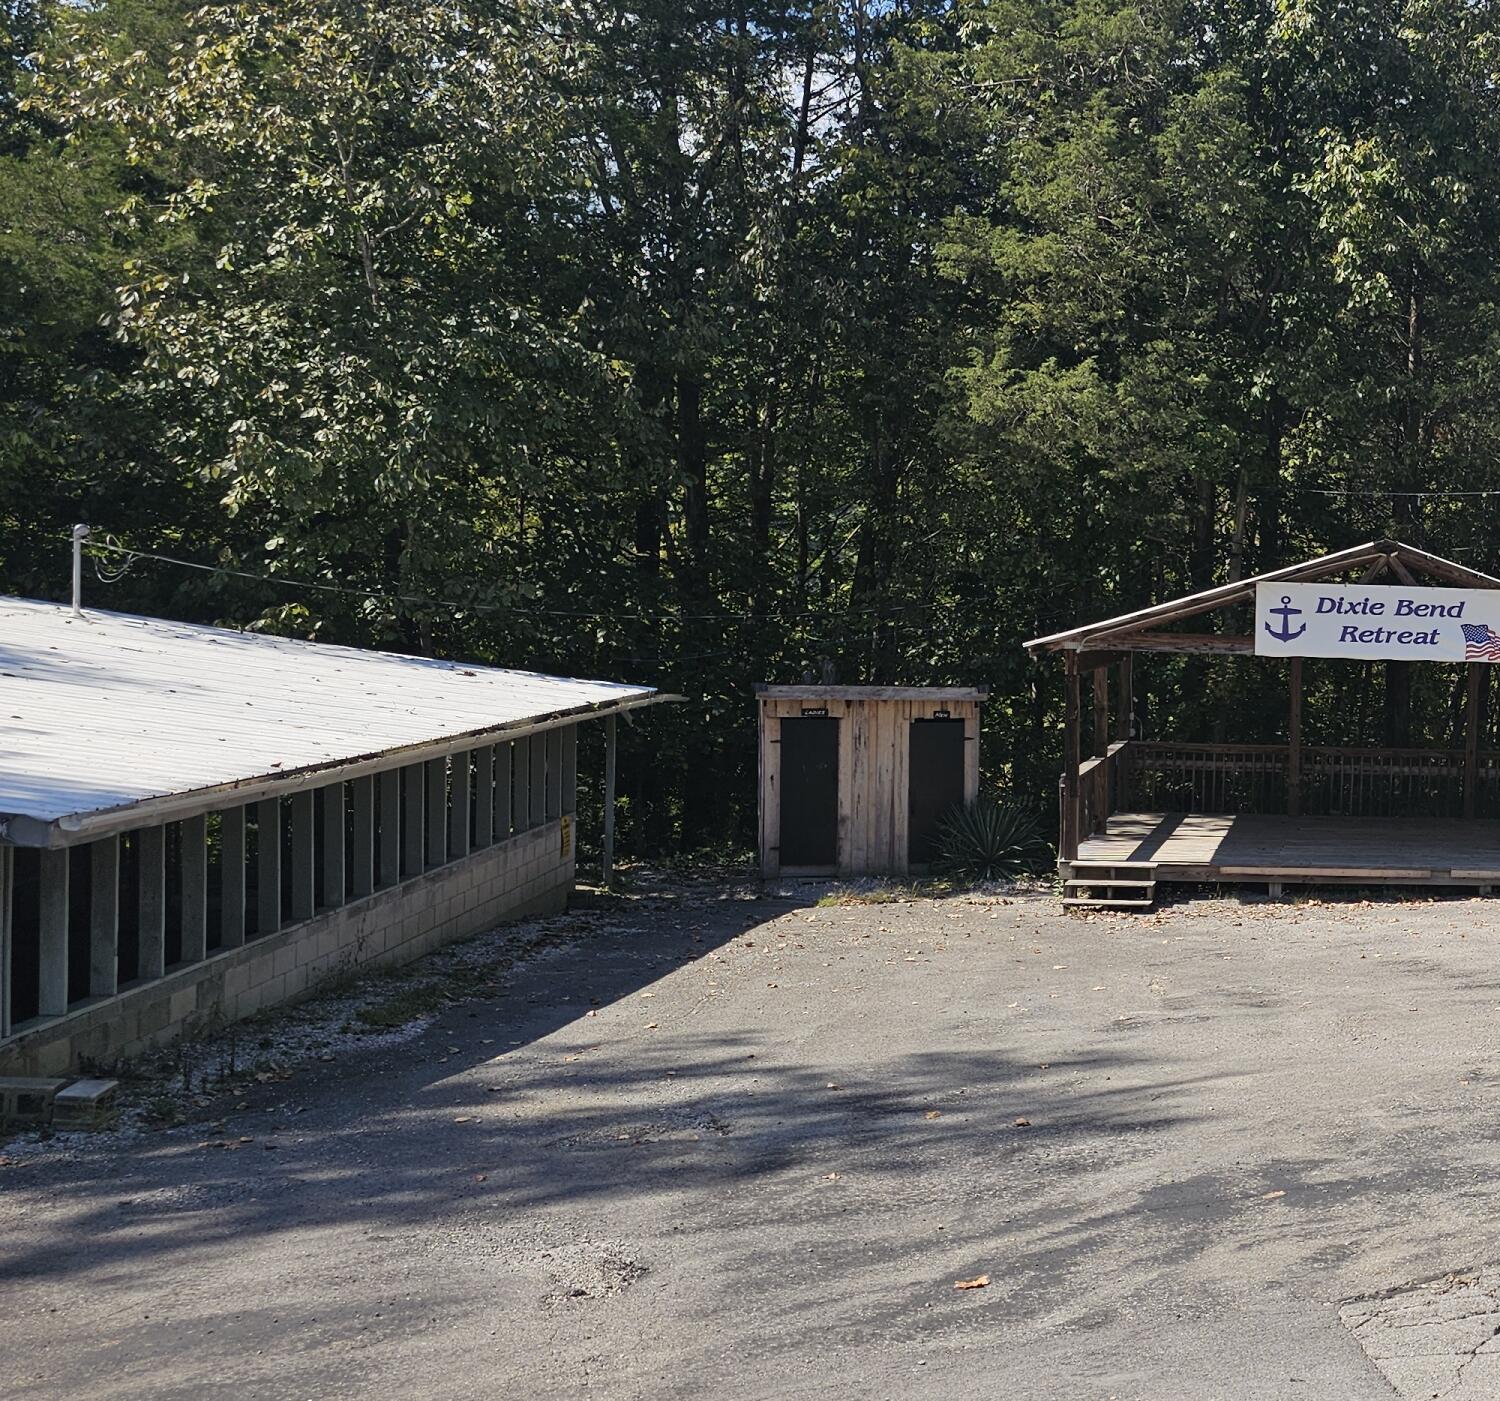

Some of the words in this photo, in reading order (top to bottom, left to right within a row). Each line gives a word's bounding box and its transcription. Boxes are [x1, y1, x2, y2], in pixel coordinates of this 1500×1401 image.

[1315, 597, 1385, 616] Dixie
[1394, 599, 1465, 619] Bend
[1339, 625, 1441, 645] Retreat
